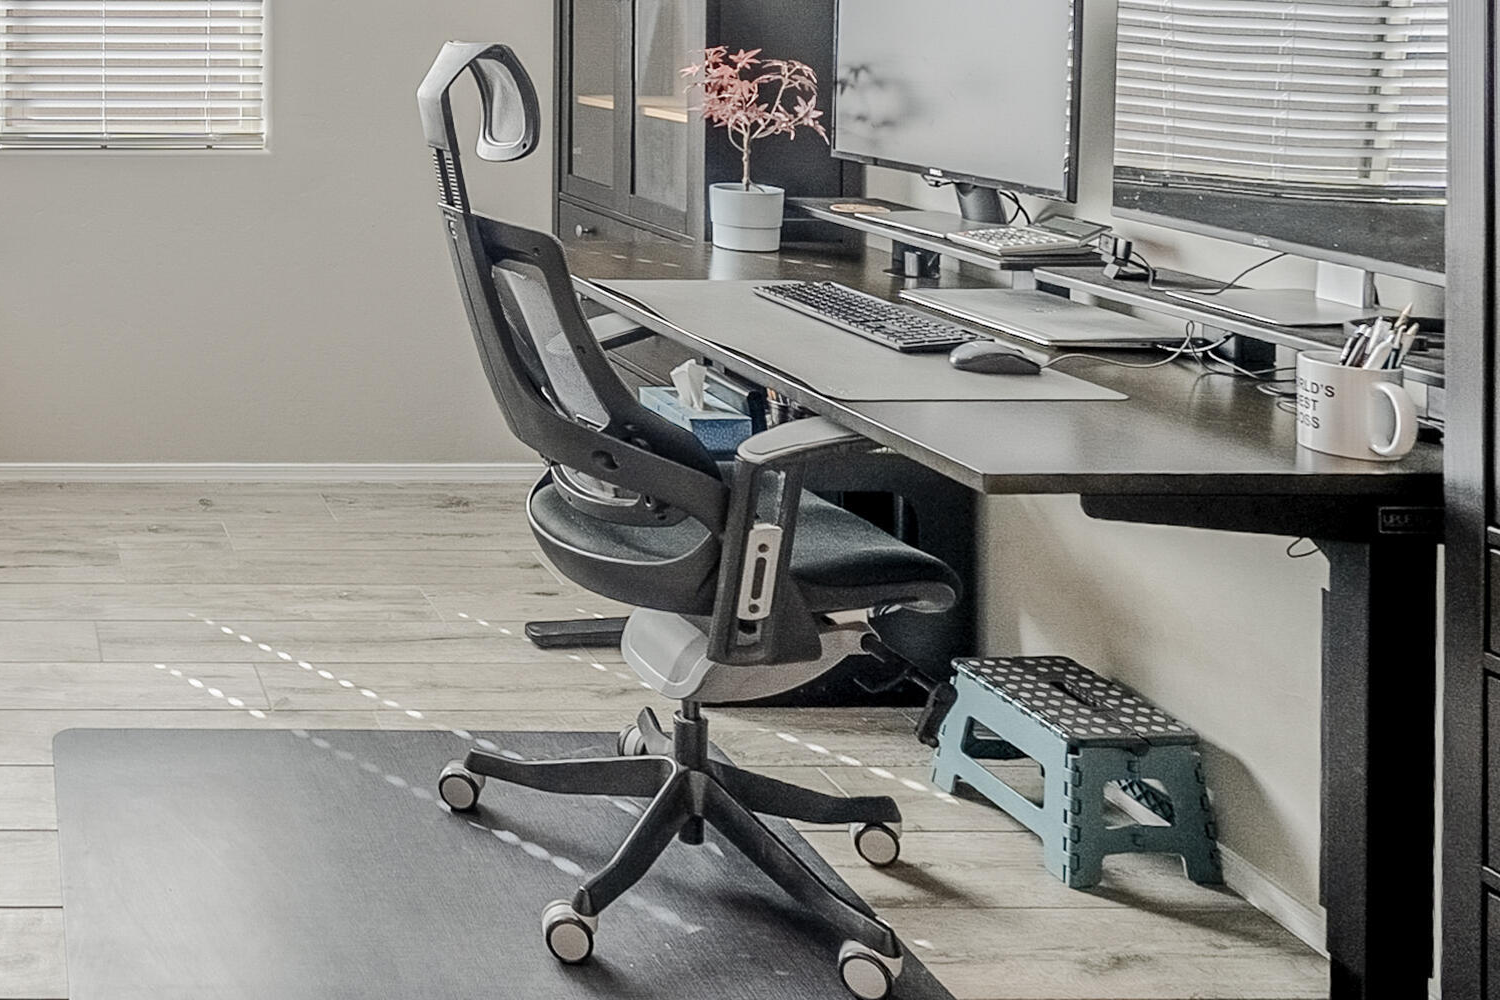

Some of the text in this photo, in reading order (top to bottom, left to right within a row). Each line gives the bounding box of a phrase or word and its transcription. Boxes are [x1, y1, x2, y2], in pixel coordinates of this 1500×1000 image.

[1300, 378, 1335, 398] RLD'S
[1299, 394, 1319, 411] EST
[1299, 411, 1320, 429] OSS
